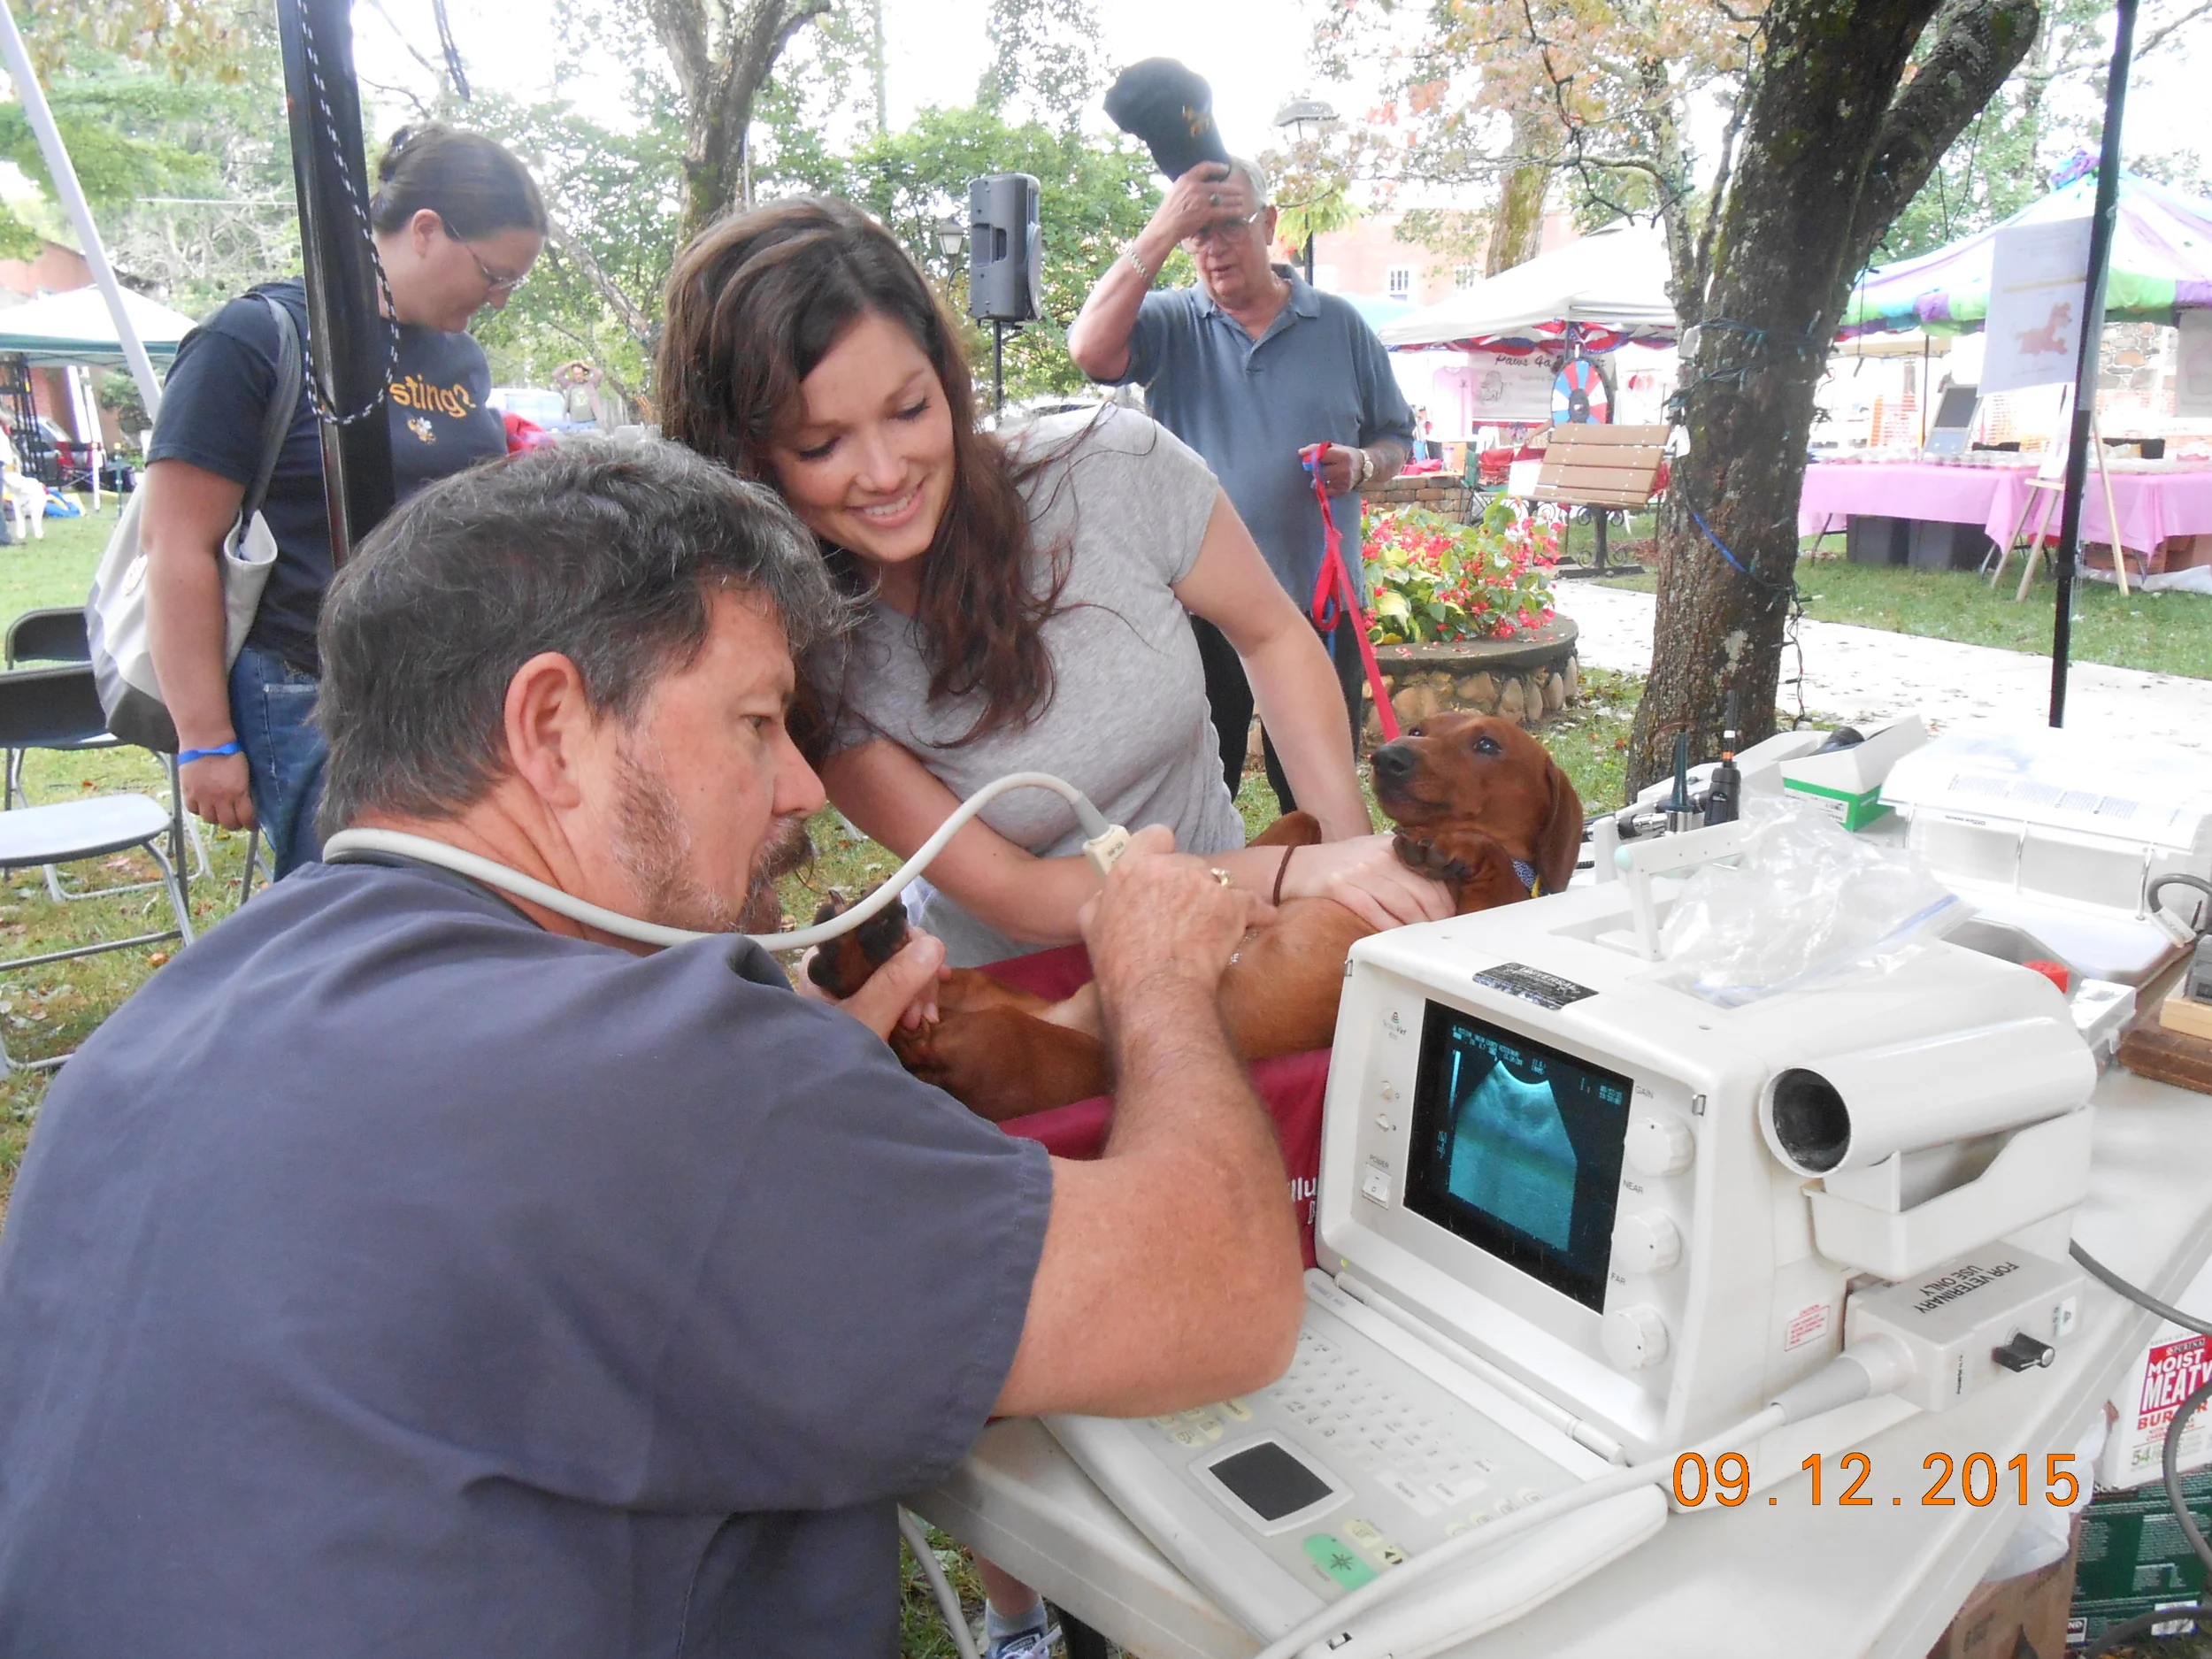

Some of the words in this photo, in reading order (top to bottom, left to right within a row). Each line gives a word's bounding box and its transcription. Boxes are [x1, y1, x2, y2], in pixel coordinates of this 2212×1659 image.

[1495, 355, 1528, 367] Paws
[1634, 1085, 1654, 1099] GAIN
[1623, 1179, 1644, 1194] NEAR
[1950, 1264, 1984, 1280] USE
[1987, 1261, 2019, 1277] FOR
[1914, 1274, 1995, 1314] VETERINARY
[1919, 1277, 1956, 1296] ONLY
[2147, 1348, 2206, 1379] MOIST
